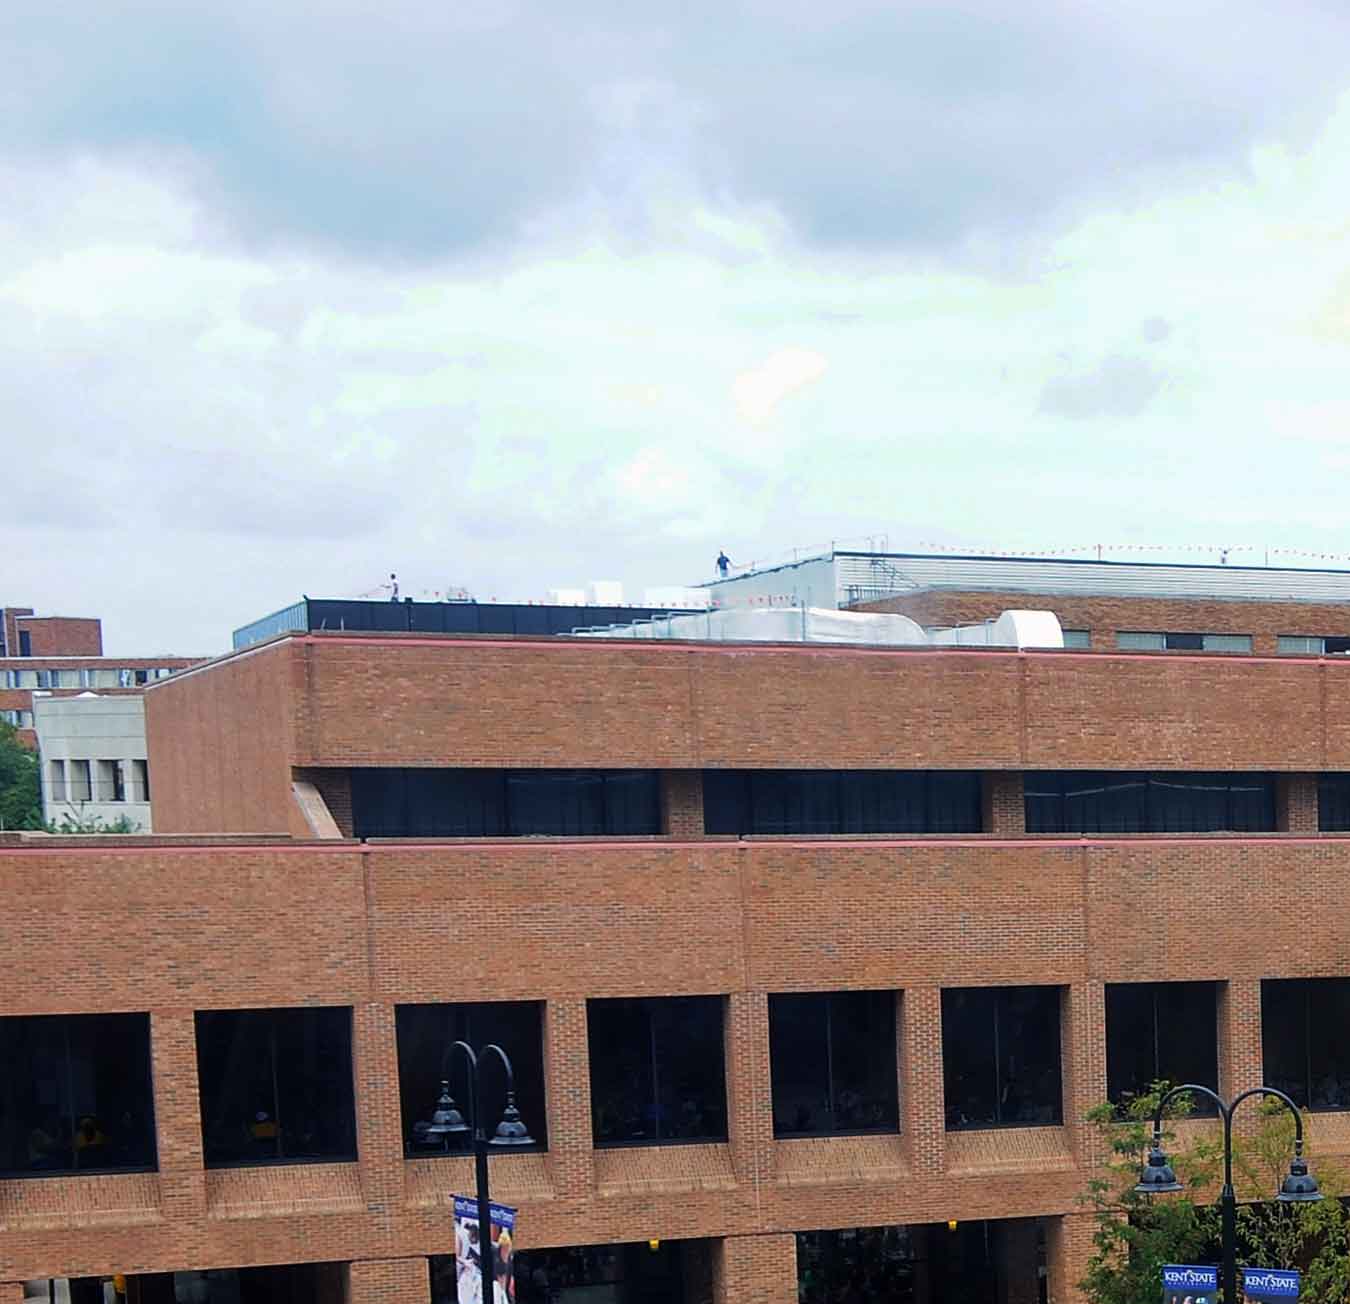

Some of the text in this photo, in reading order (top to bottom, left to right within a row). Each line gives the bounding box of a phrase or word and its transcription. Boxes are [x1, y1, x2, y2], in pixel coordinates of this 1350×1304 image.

[1164, 1271, 1217, 1283] KENT STATE
[1245, 1275, 1298, 1289] KENT STATE
